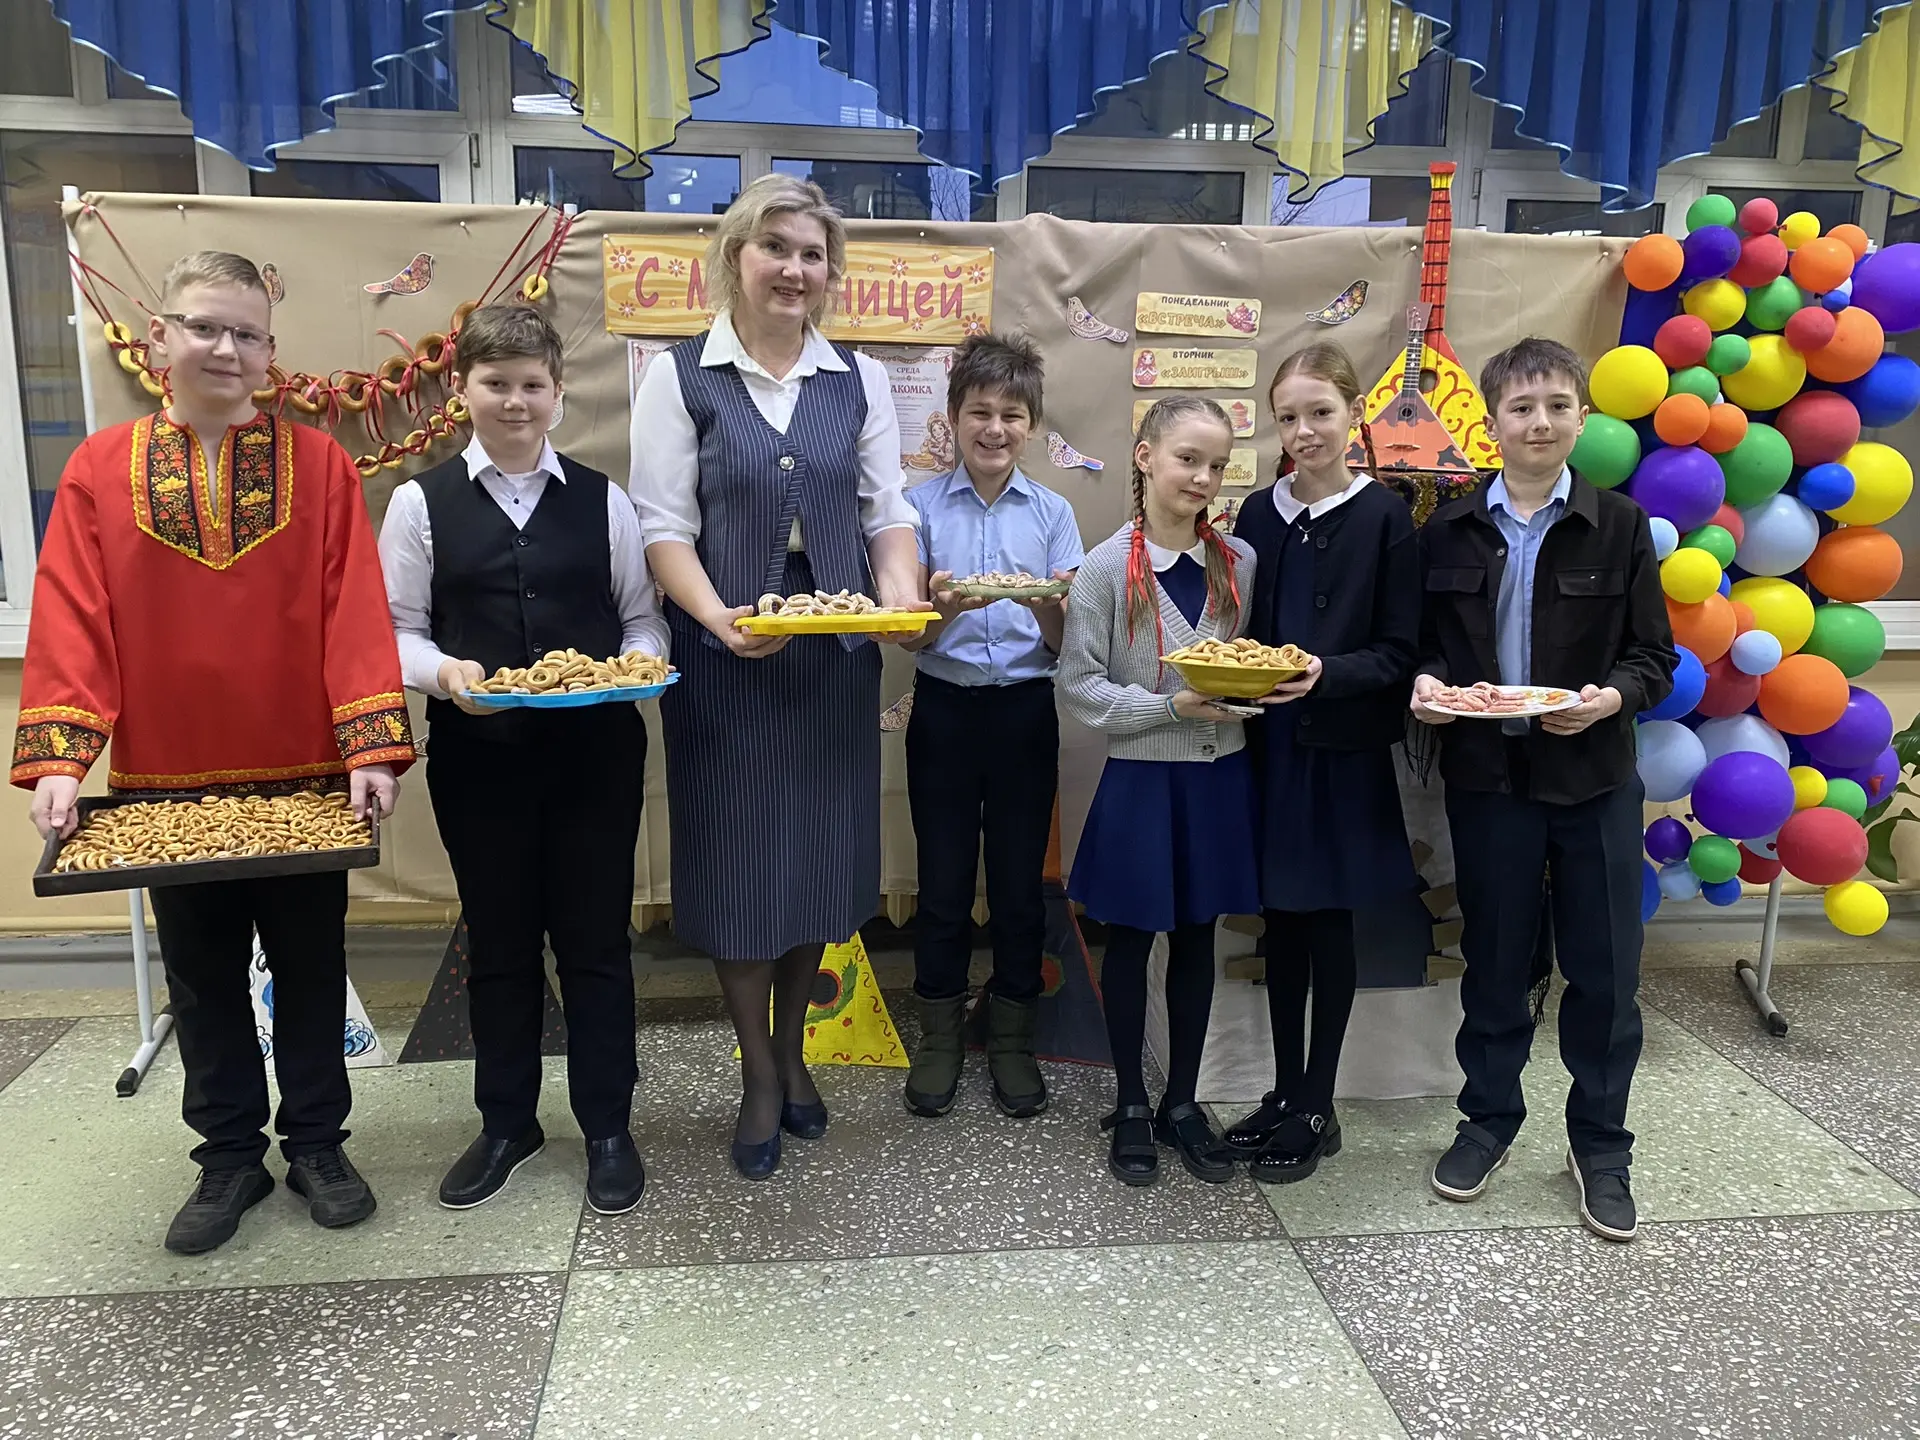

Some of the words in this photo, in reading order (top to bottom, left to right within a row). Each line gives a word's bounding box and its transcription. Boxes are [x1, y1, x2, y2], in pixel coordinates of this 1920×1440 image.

[635, 256, 660, 309] С
[1161, 296, 1230, 308] ПОНЕДЕЛЬНИК
[1137, 311, 1227, 329] «ВСТРЕЧА»
[1172, 350, 1214, 359] ВТОРНИК
[896, 366, 921, 375] СРЕДА
[1160, 366, 1249, 379] «ЗАИГРЫШ»
[889, 384, 933, 394] АКОМКА
